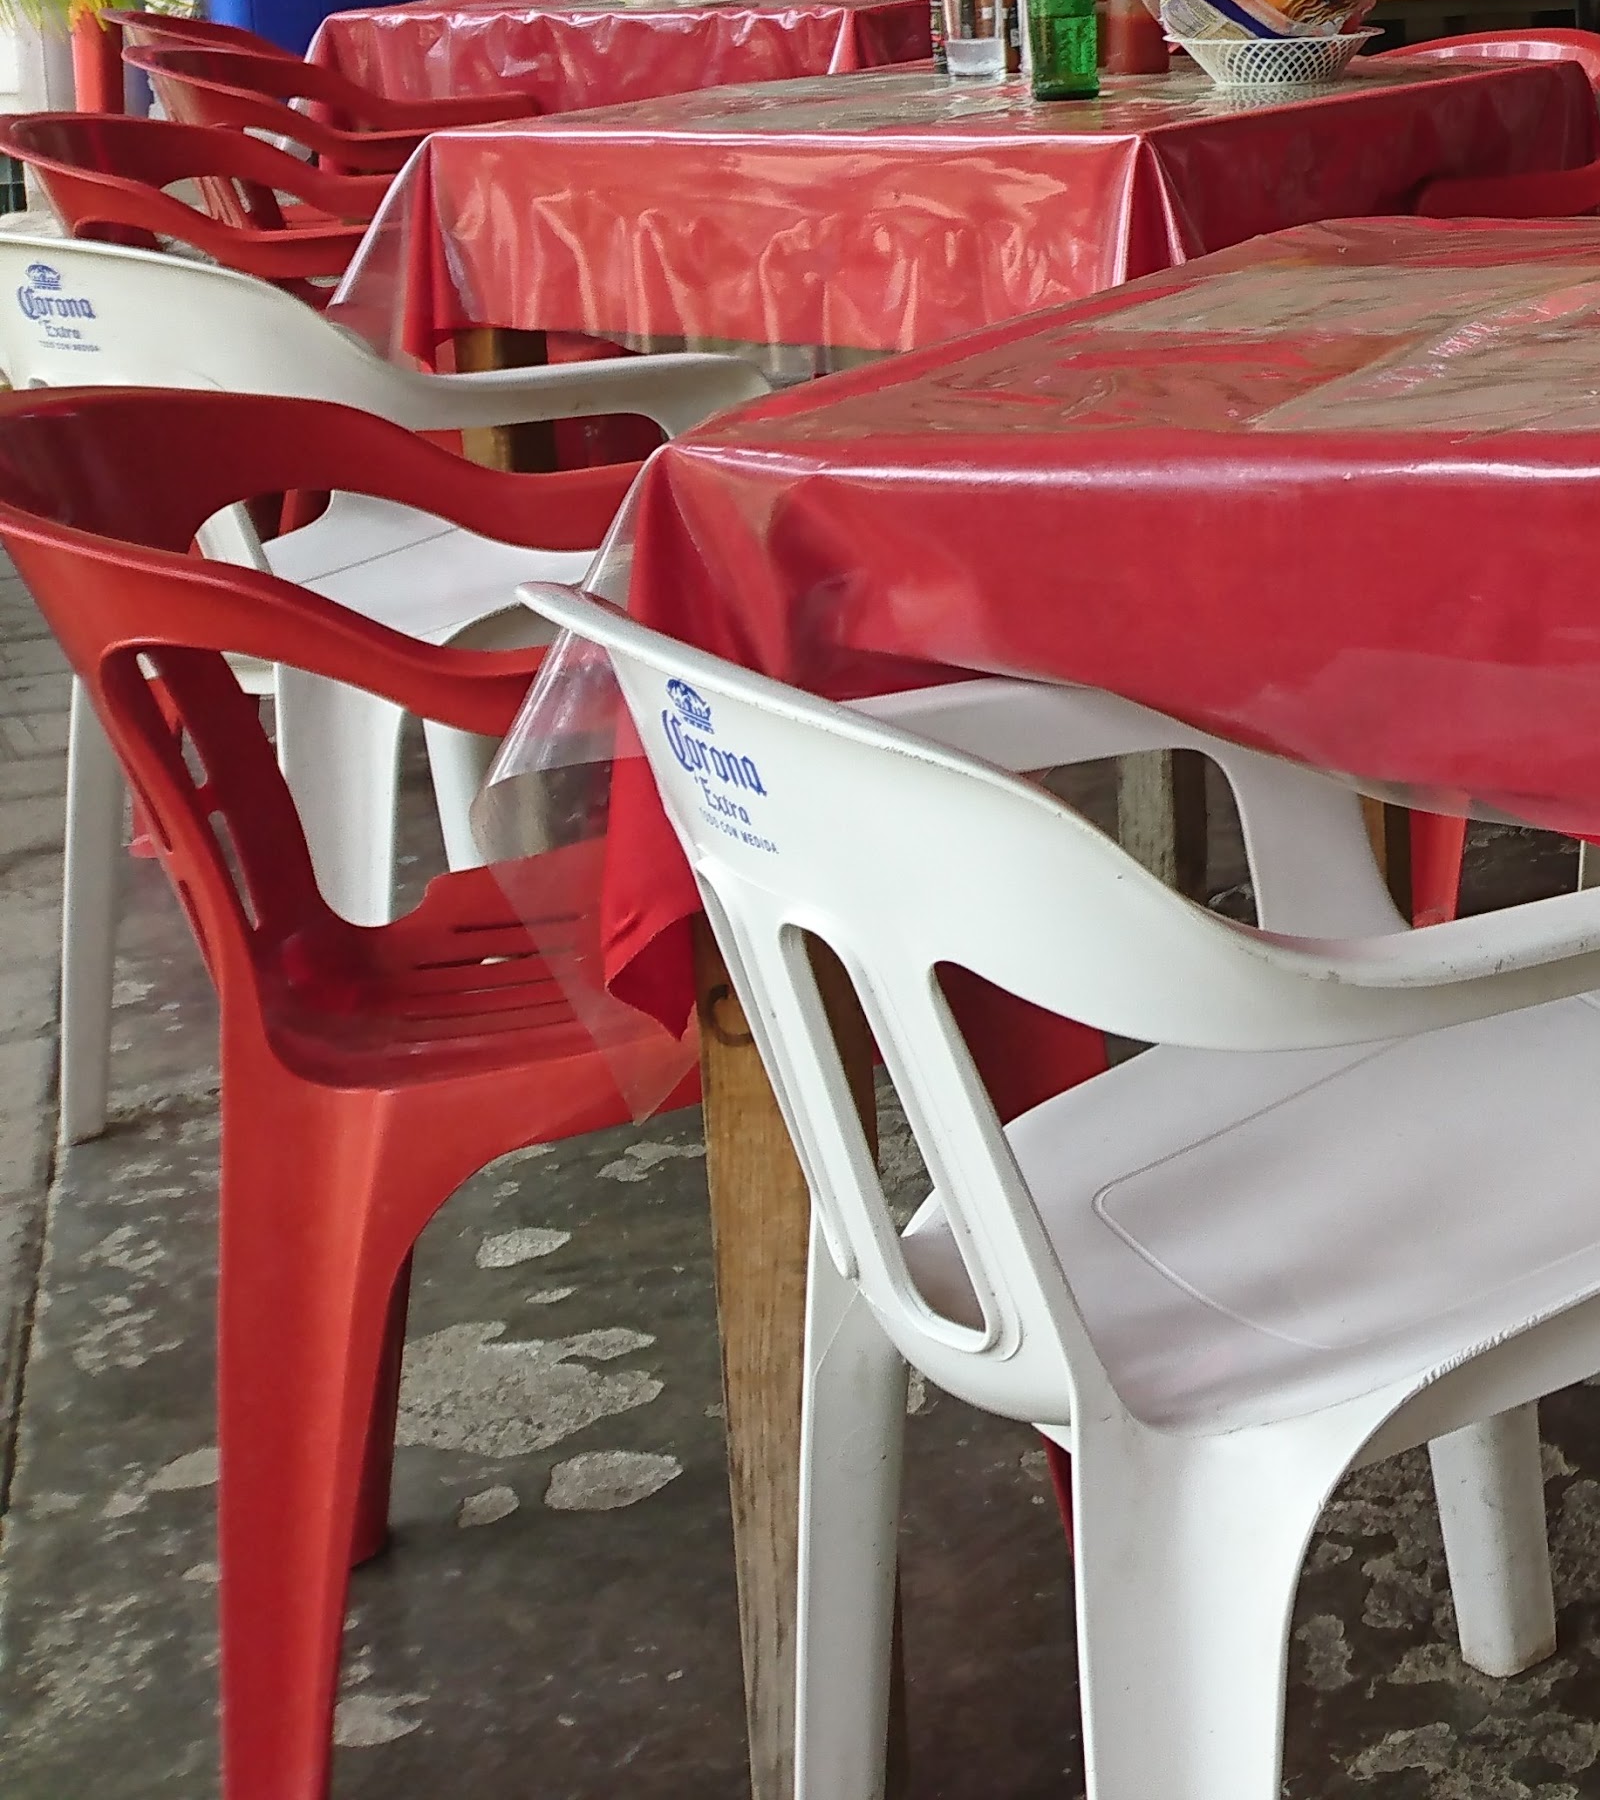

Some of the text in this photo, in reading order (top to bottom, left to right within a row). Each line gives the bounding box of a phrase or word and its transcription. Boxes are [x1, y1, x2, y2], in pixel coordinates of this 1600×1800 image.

[17, 286, 96, 320] Corona
[662, 710, 768, 798] Corona
[696, 776, 752, 826] Extra
